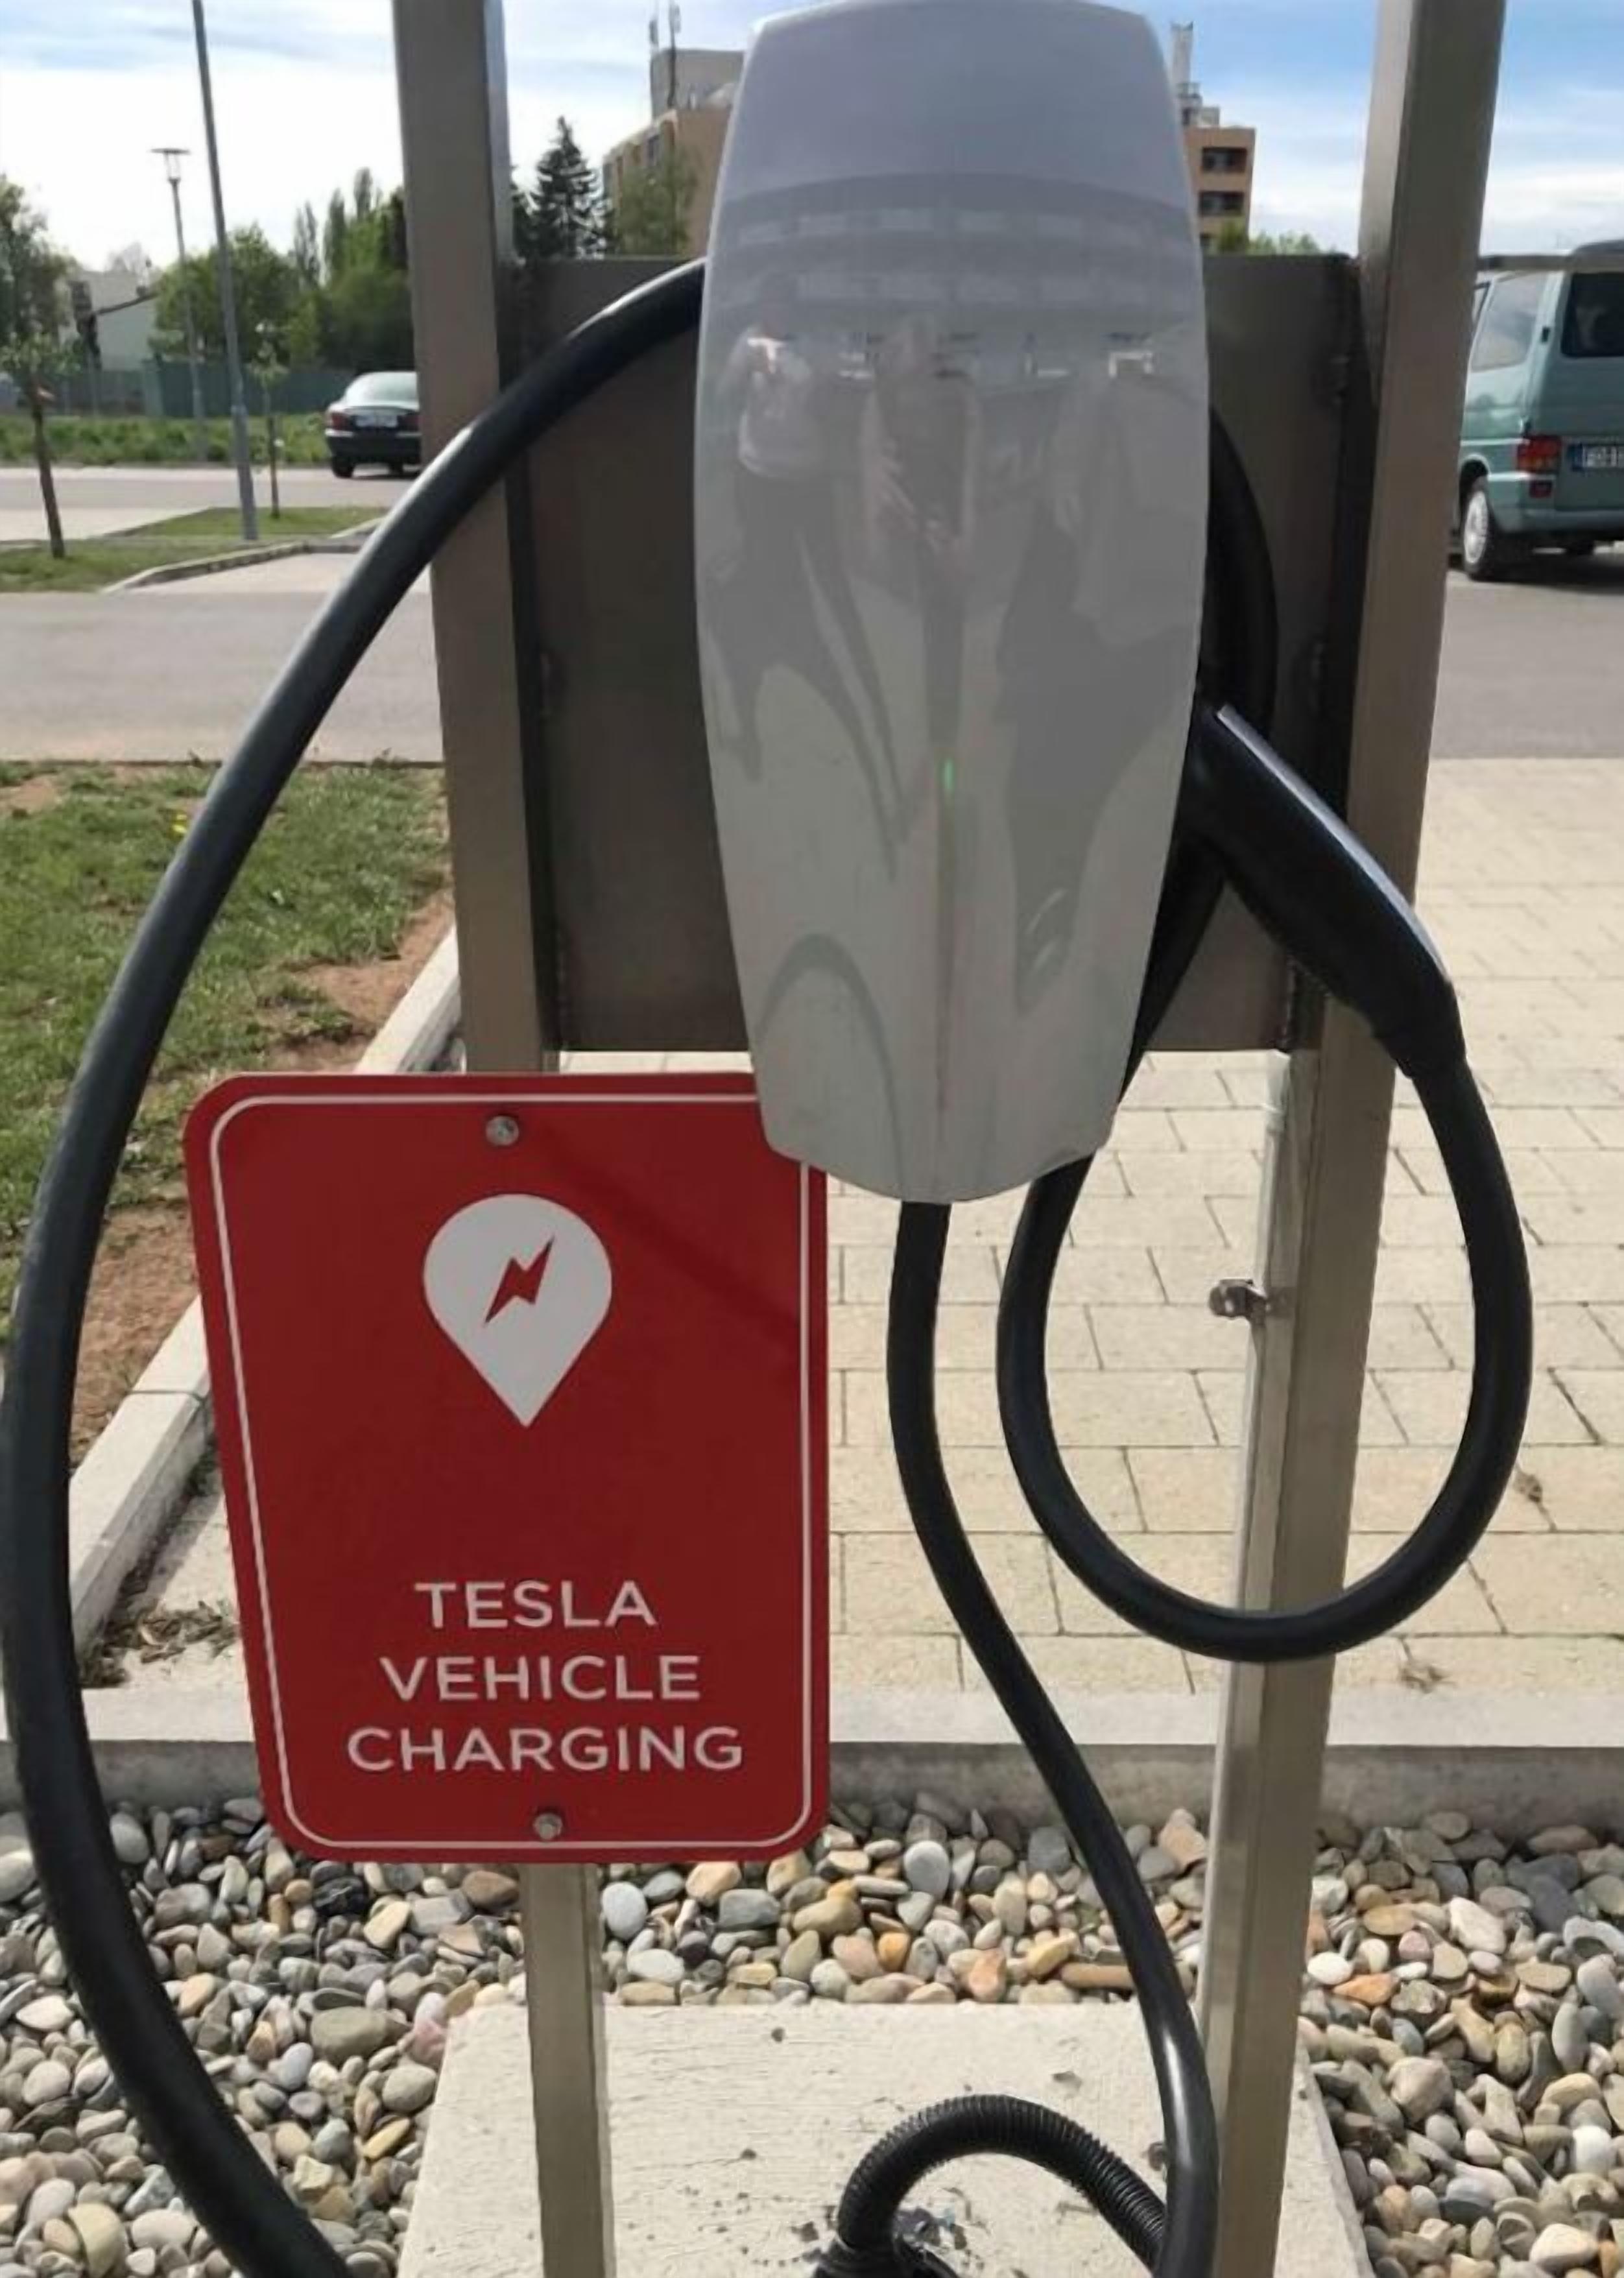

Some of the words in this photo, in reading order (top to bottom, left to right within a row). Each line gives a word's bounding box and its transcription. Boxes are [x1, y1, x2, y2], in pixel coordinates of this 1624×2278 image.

[414, 1580, 658, 1629] TESLA
[379, 1655, 700, 1701] VEHICLE
[347, 1726, 743, 1771] CHARGING
